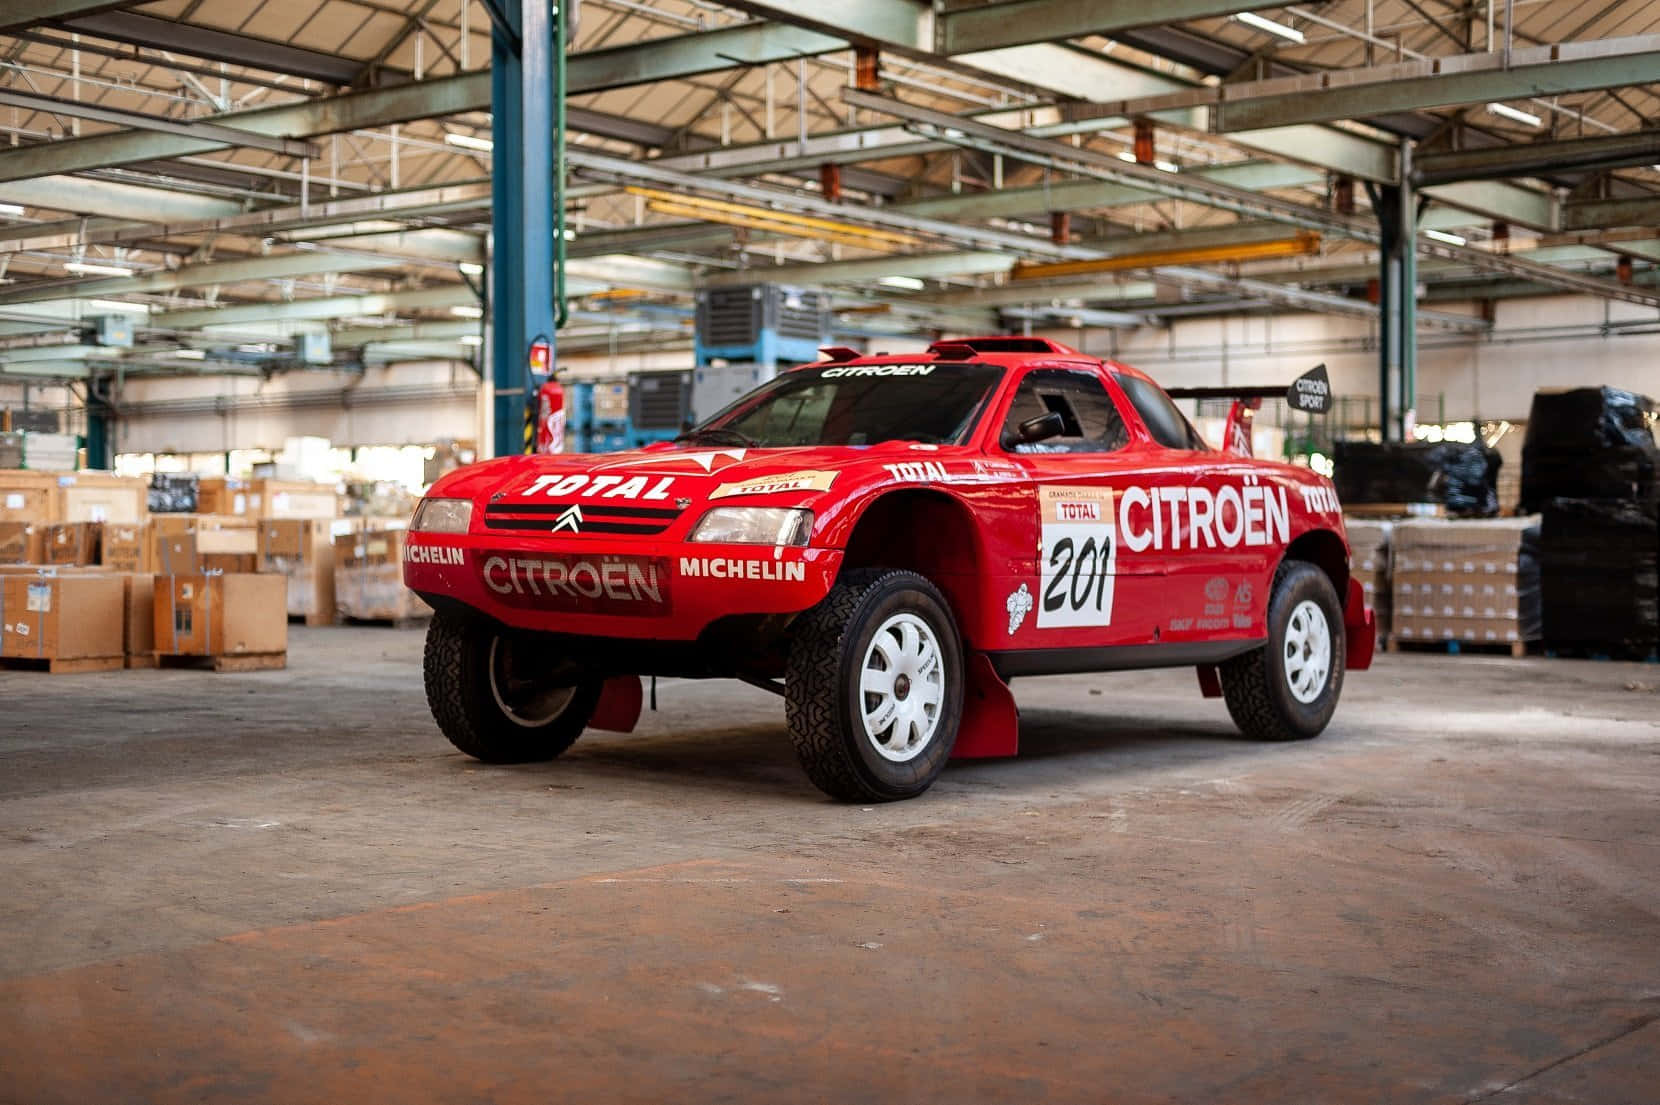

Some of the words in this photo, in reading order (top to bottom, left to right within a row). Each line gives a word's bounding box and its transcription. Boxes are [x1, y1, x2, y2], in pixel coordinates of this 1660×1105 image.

[821, 365, 936, 377] CITROEN
[1299, 394, 1324, 408] SPORT
[882, 461, 949, 481] TOTAL
[522, 474, 676, 499] TOTAL
[741, 482, 800, 492] TOTAL
[1062, 503, 1096, 519] TOTAL
[1119, 474, 1290, 552] CITROËN
[483, 550, 663, 602] CITROËN
[680, 557, 806, 581] MICHELIN
[1044, 537, 1110, 612] 201
